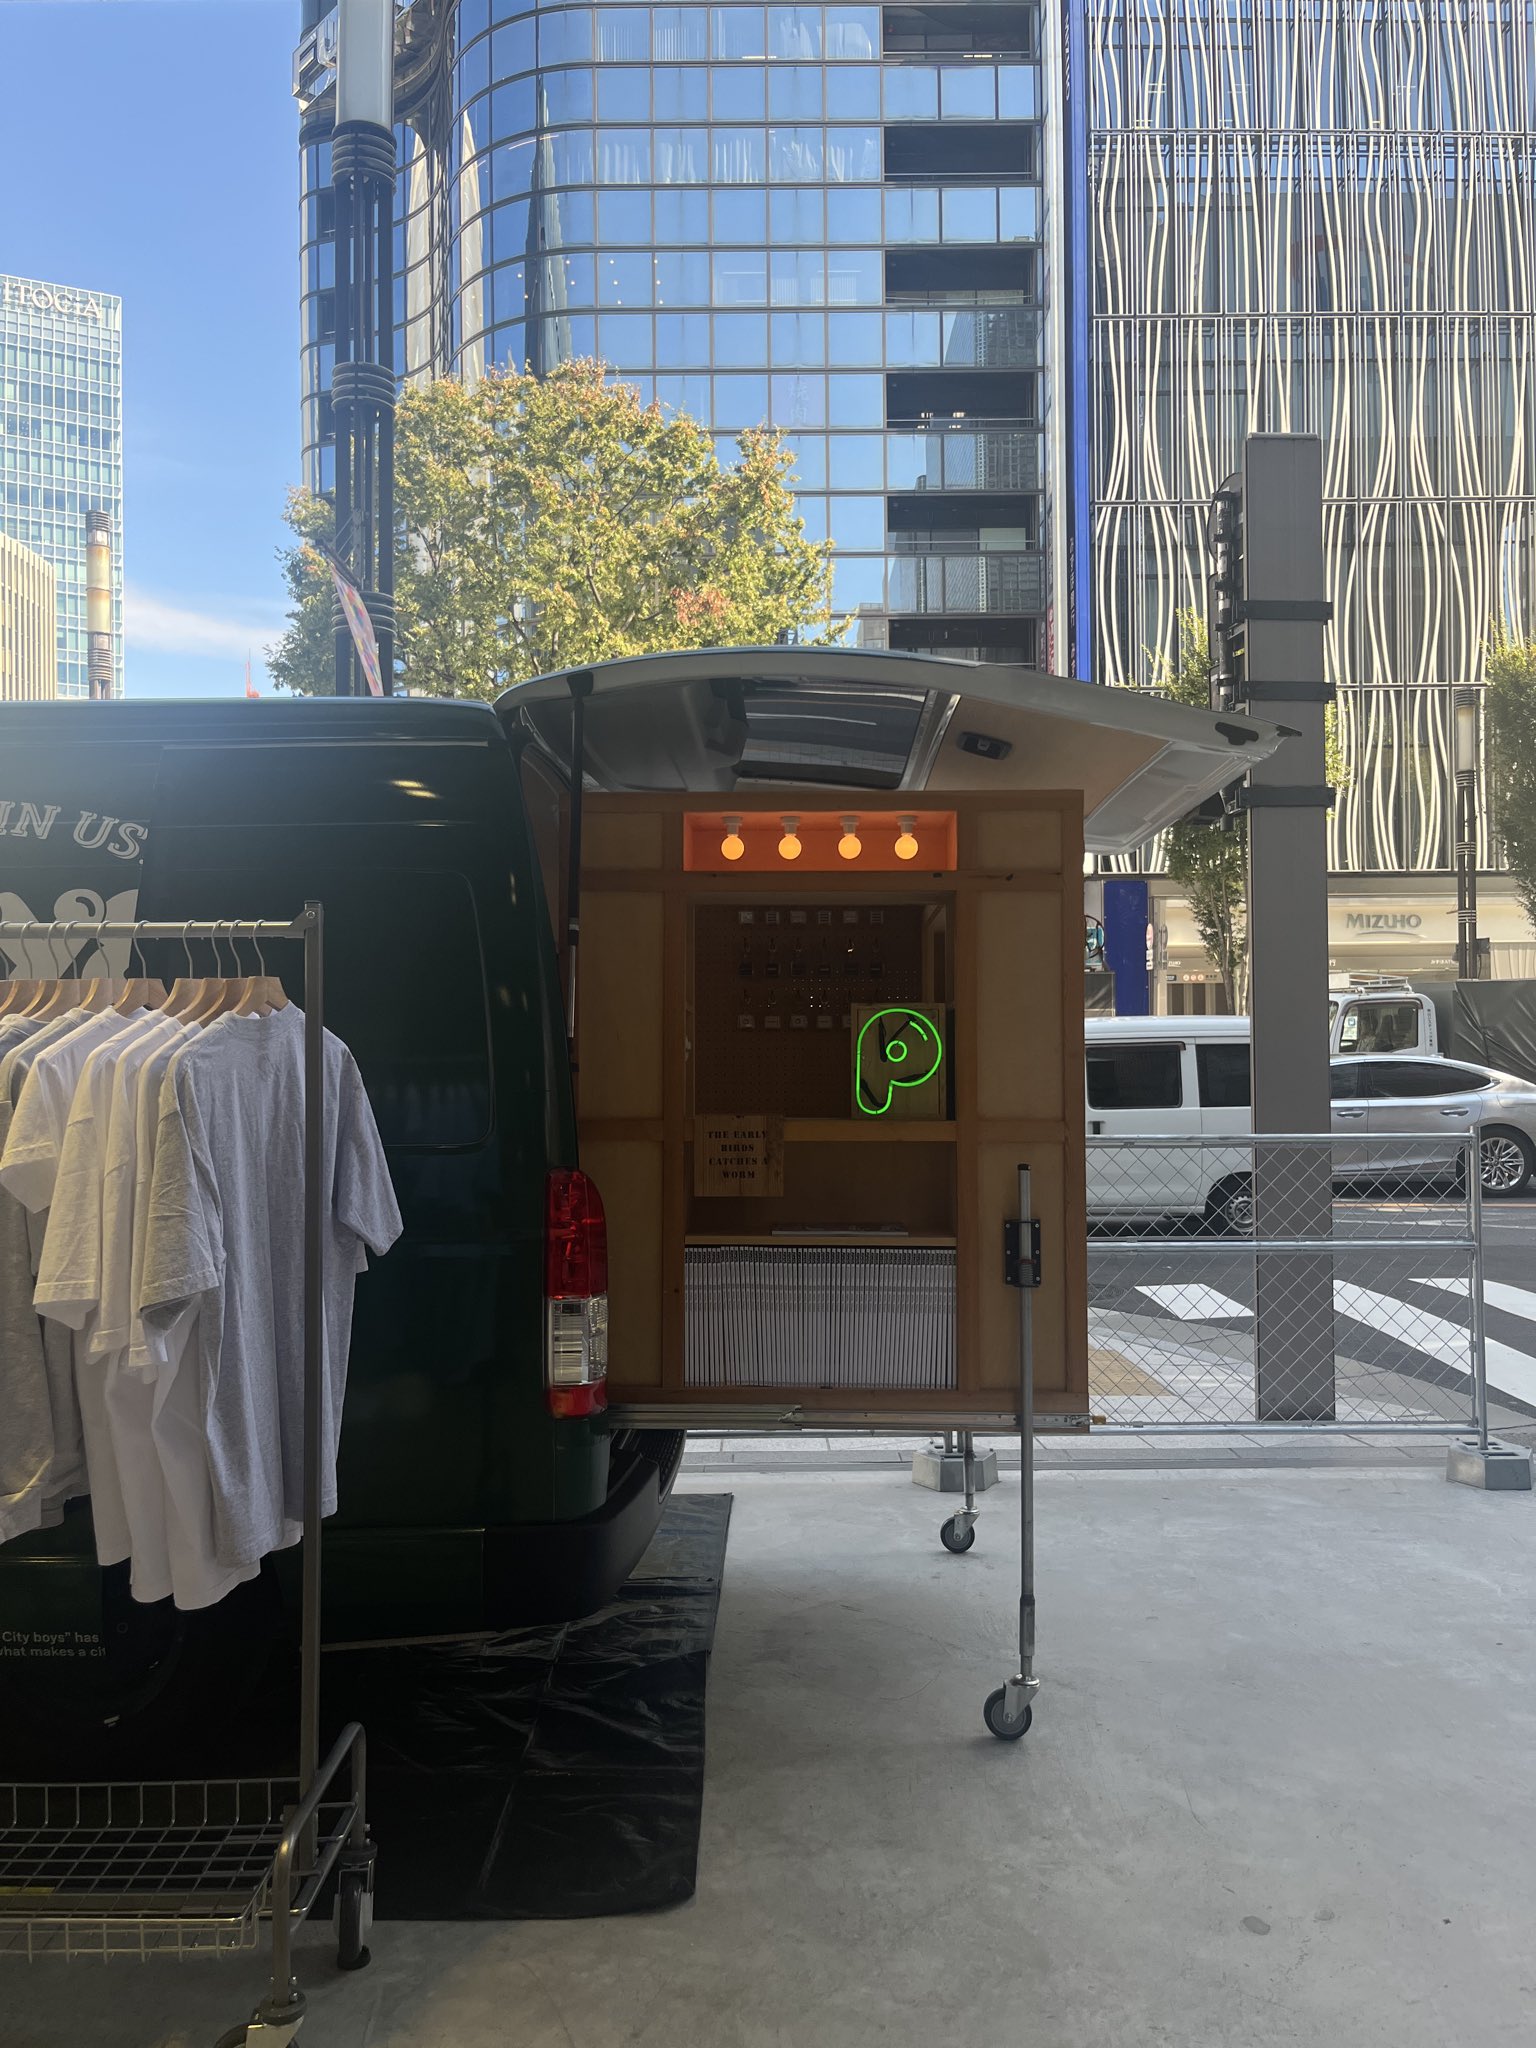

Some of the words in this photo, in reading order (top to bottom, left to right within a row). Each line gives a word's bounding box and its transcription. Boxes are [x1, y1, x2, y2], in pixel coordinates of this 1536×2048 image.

[1346, 912, 1422, 929] MIZUHO
[707, 1130, 730, 1139] THE
[733, 1130, 768, 1139] EARLY
[720, 1144, 755, 1152] BIRDS
[708, 1157, 758, 1166] CATCHES
[721, 1170, 756, 1179] WORM
[2, 1631, 30, 1645] City
[74, 1631, 100, 1643] has
[30, 1646, 75, 1657] makes
[78, 1648, 87, 1657] a
